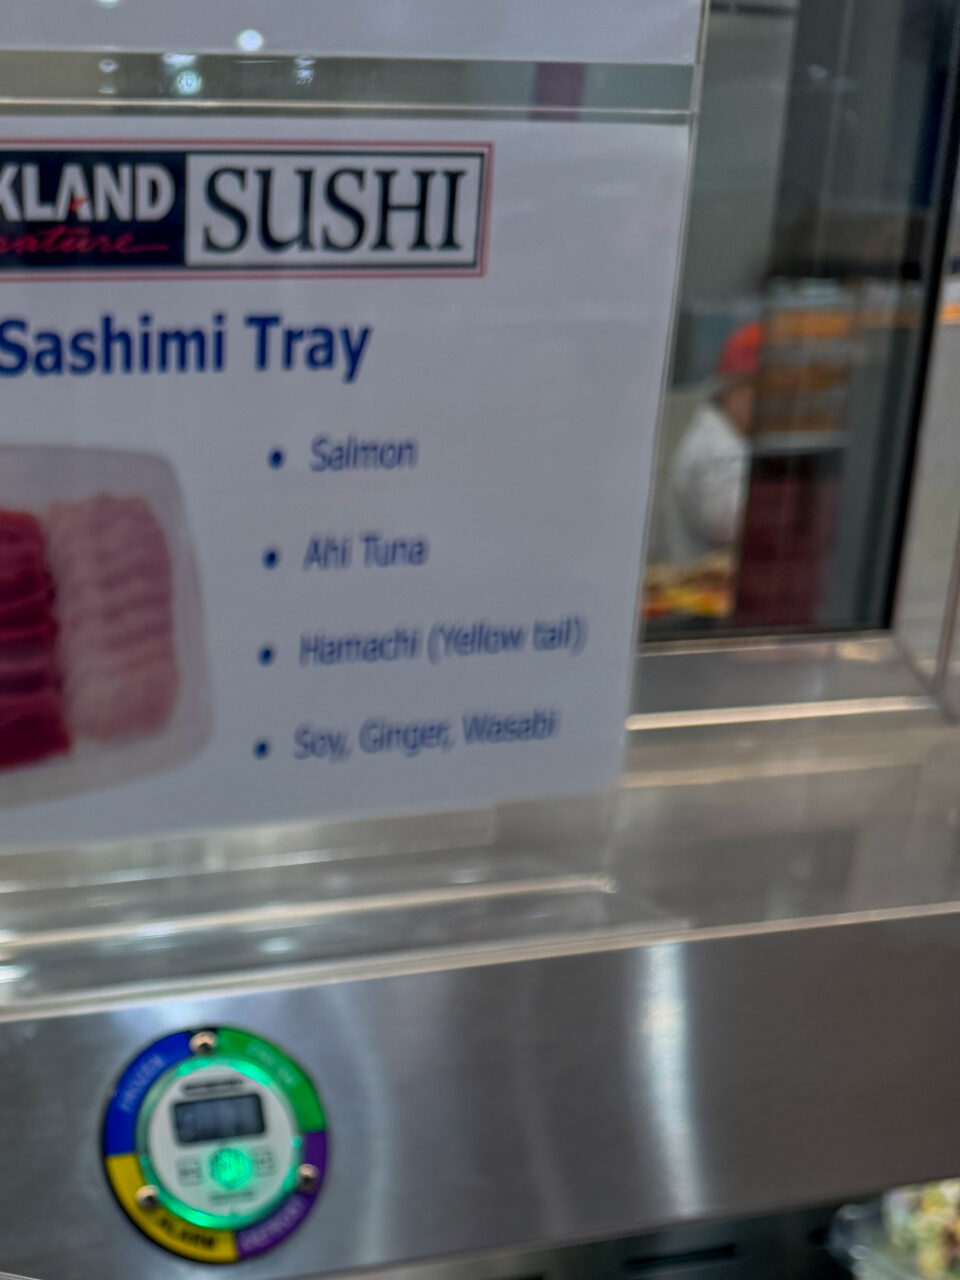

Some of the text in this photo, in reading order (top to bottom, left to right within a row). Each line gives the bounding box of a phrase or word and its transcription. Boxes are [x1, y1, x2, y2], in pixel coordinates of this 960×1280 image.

[202, 167, 467, 254] SUSHI
[246, 315, 371, 382] Tray
[309, 434, 418, 471] Salmon
[304, 534, 428, 570] Ahi Tuna
[298, 615, 587, 665] Hamachi (Yellow tail)
[463, 710, 559, 745] Wasabi
